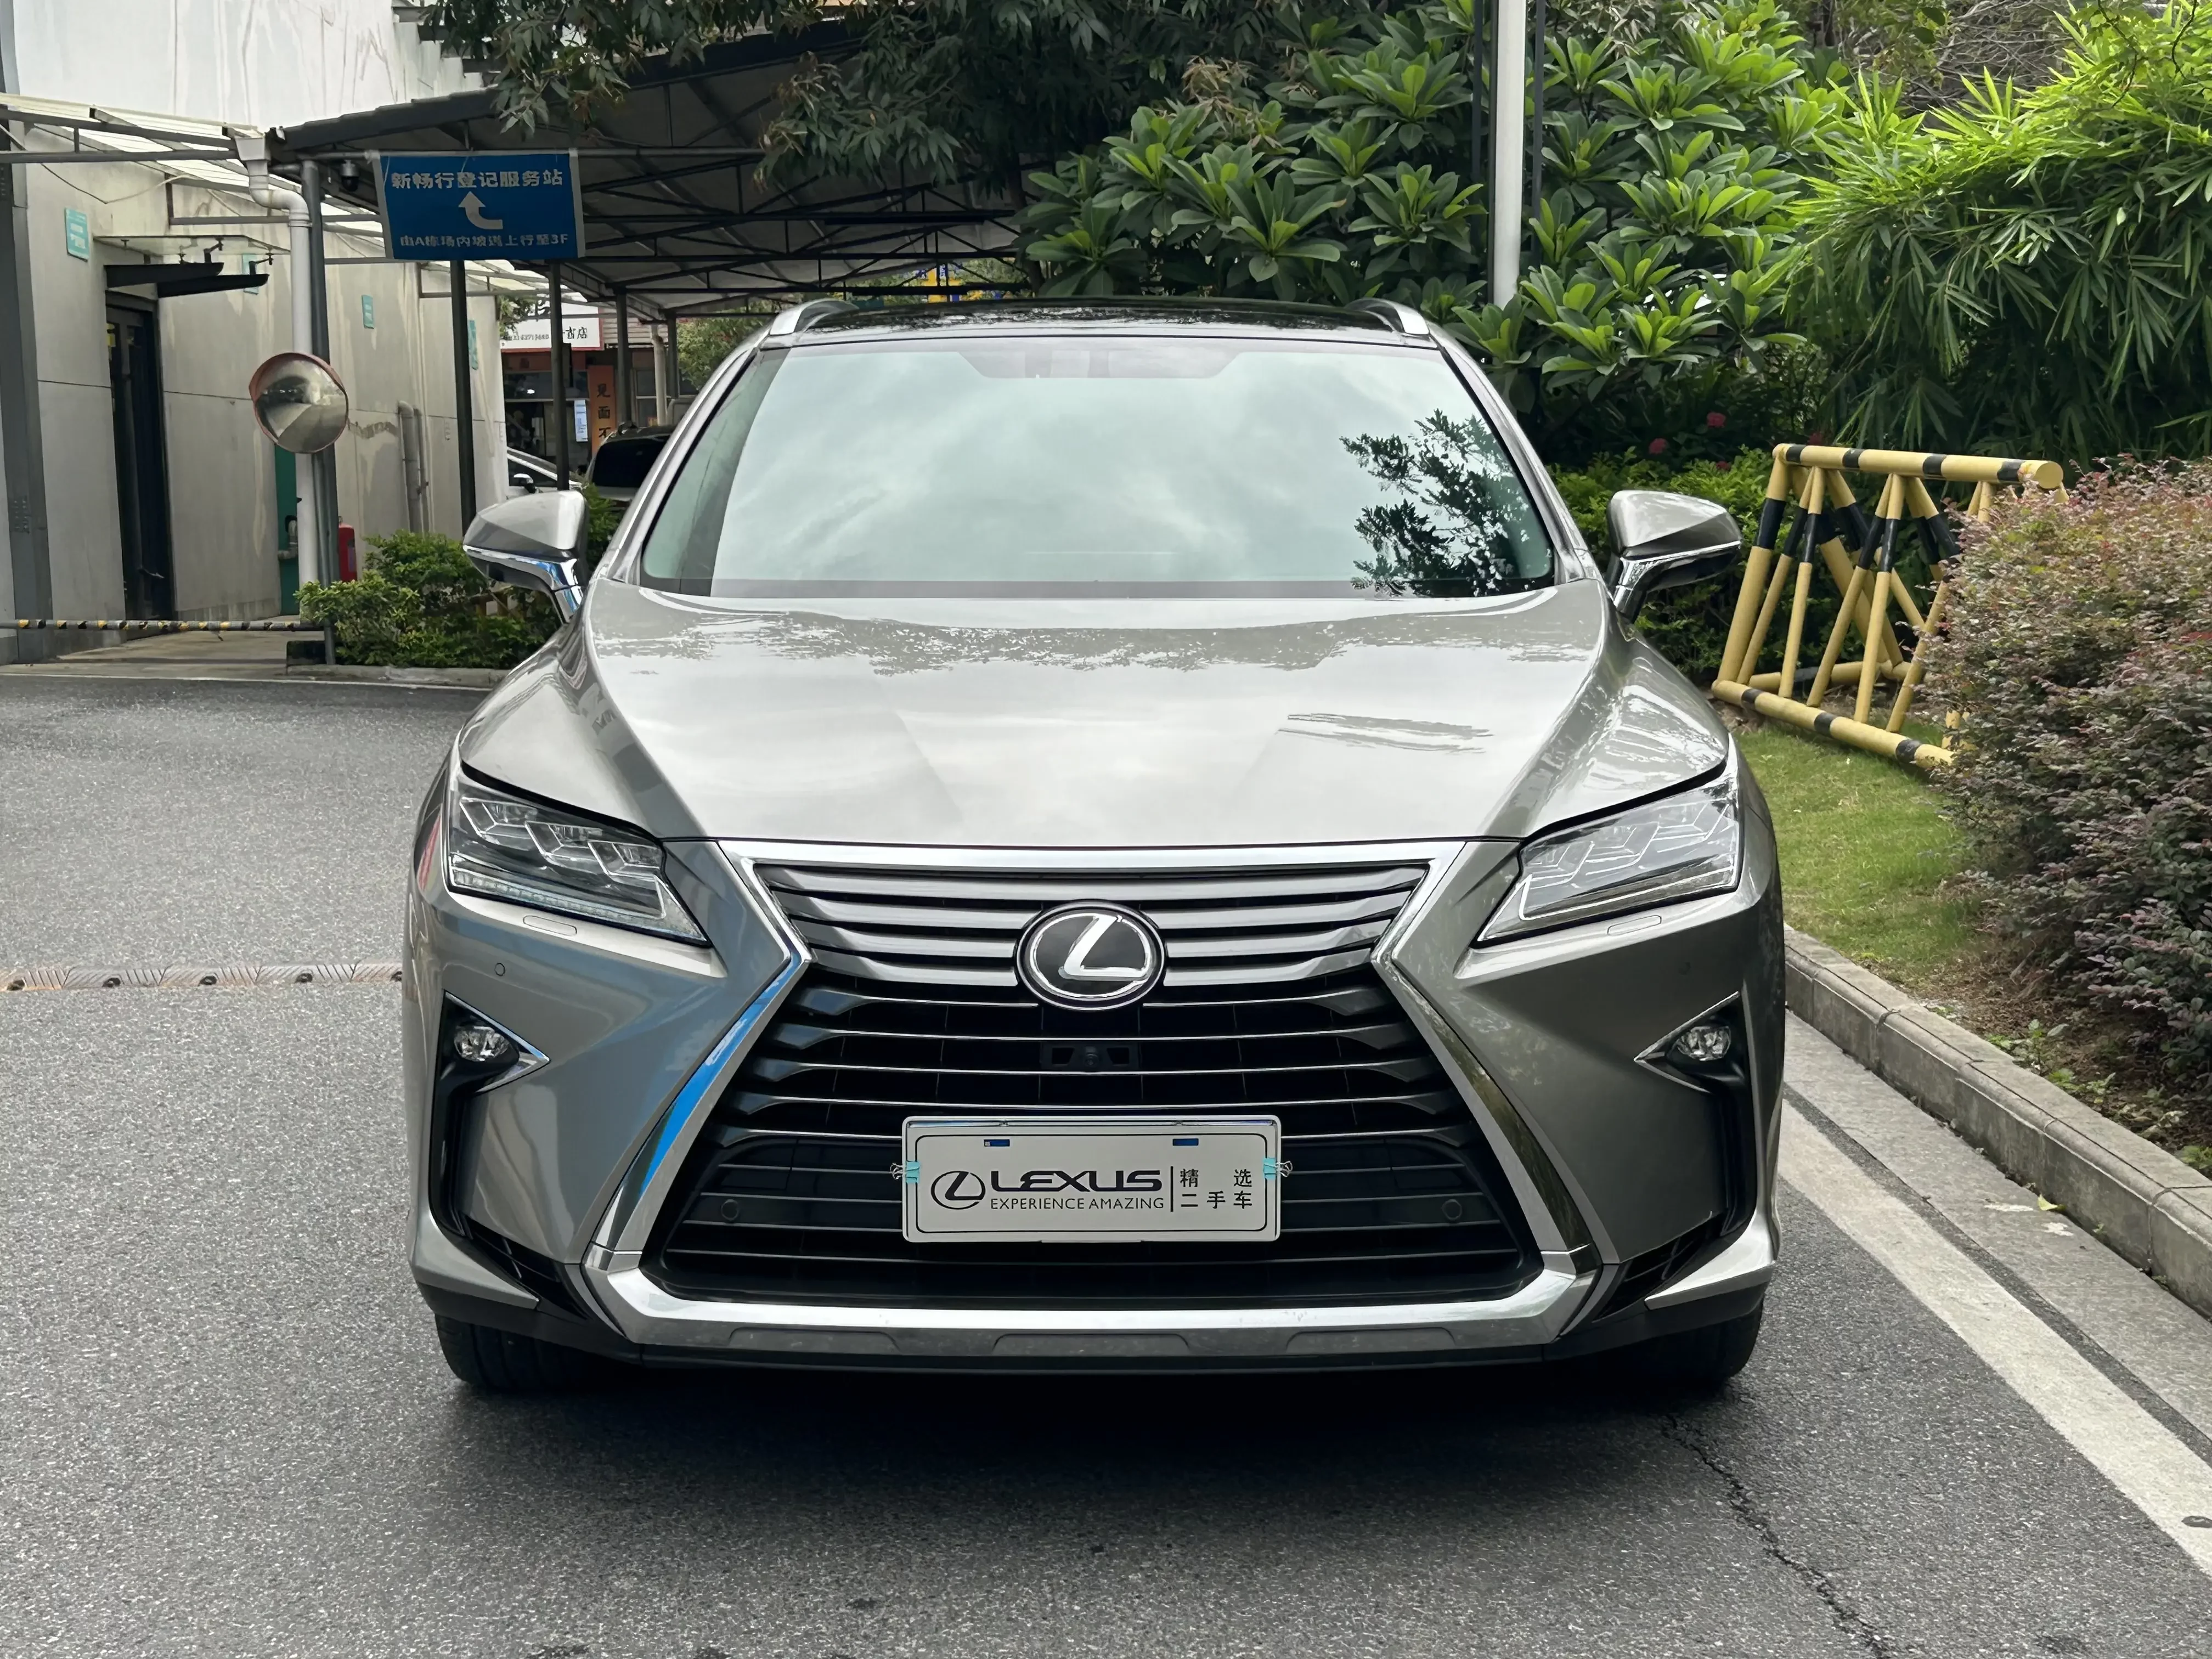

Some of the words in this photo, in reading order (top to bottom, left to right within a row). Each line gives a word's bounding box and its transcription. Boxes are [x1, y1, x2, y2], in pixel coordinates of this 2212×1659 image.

[391, 169, 563, 189] 新畅行登记服务站
[991, 1170, 1162, 1192] LEXUS
[991, 1198, 1084, 1210] EXPERIENCE
[1088, 1198, 1164, 1210] AMAZING
[1181, 1190, 1252, 1209] 二手车
